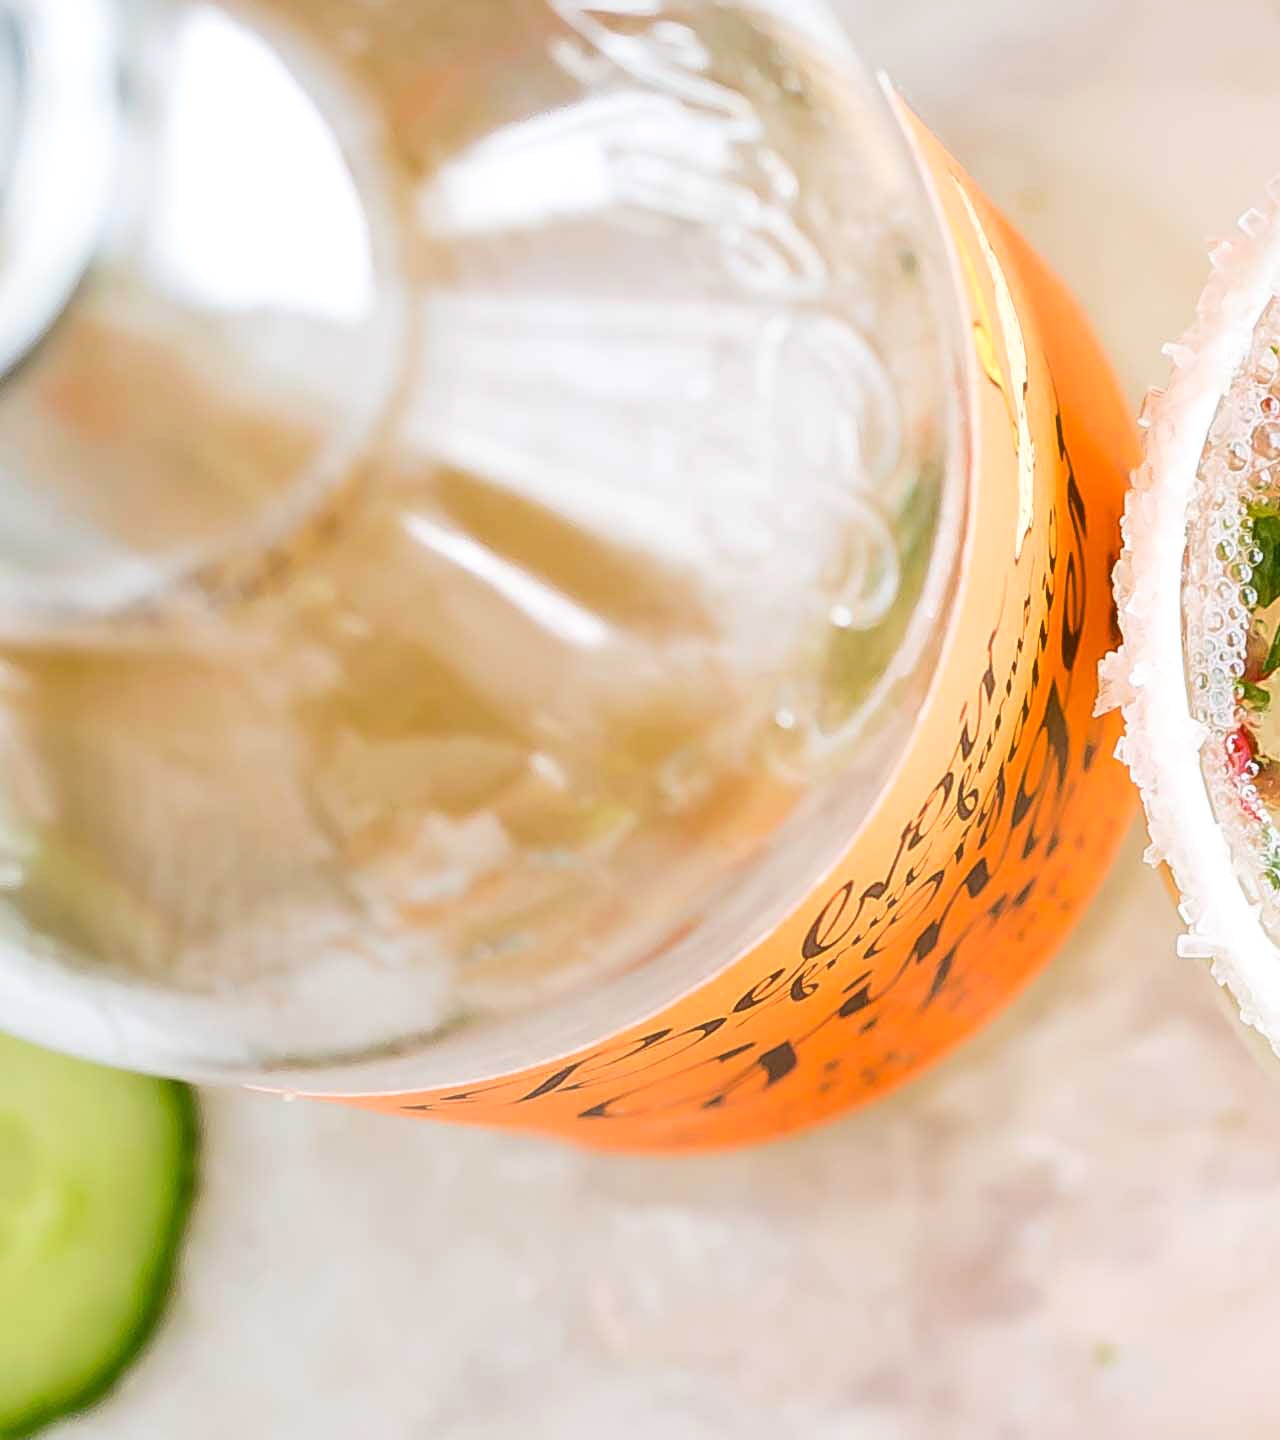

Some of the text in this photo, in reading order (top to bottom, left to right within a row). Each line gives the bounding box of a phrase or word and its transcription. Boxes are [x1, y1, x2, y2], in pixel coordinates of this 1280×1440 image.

[400, 575, 1007, 1111] Belvoir
[575, 367, 1088, 1119] Ginger
[736, 847, 930, 1027] fruit
[942, 560, 1034, 831] farms
[862, 504, 1058, 960] Organic
